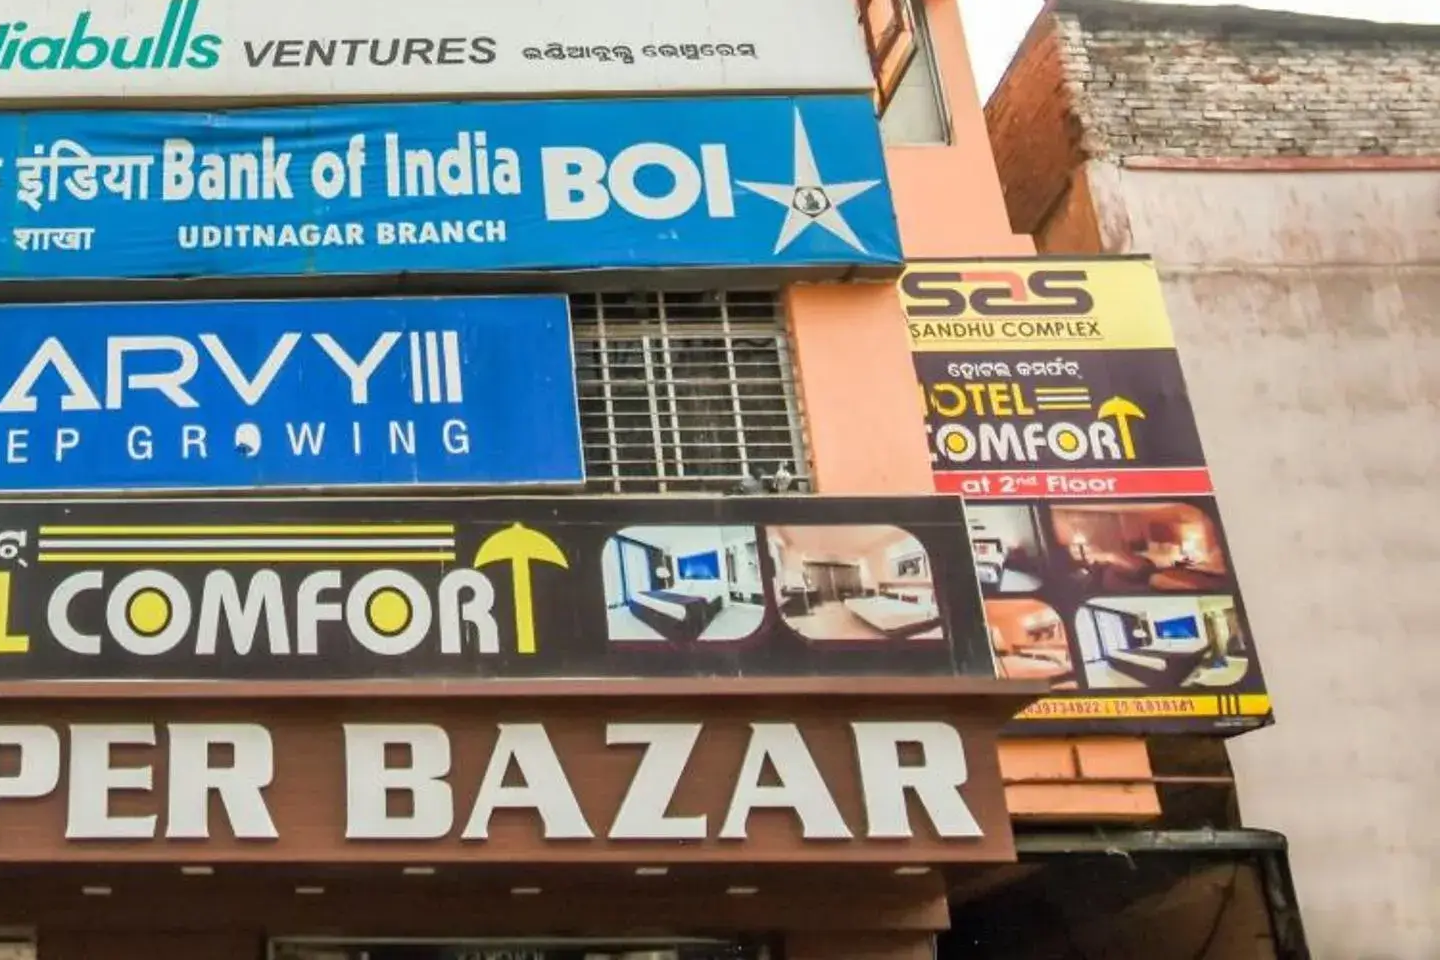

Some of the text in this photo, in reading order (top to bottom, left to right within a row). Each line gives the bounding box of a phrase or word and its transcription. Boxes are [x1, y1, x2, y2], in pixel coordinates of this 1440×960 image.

[244, 36, 497, 68] VENTURES
[16, 139, 154, 211] इंडिया
[162, 130, 522, 202] Bank of India
[540, 142, 736, 221] BOI
[13, 224, 95, 252] शाखा
[176, 220, 508, 249] UDITNAGAR BRANCH
[910, 320, 1102, 339] SANDHU COMPLEX
[961, 474, 991, 493] at
[1046, 474, 1118, 493] Floor
[46, 521, 569, 656] COMFORT
[341, 720, 985, 839] BAZAR
